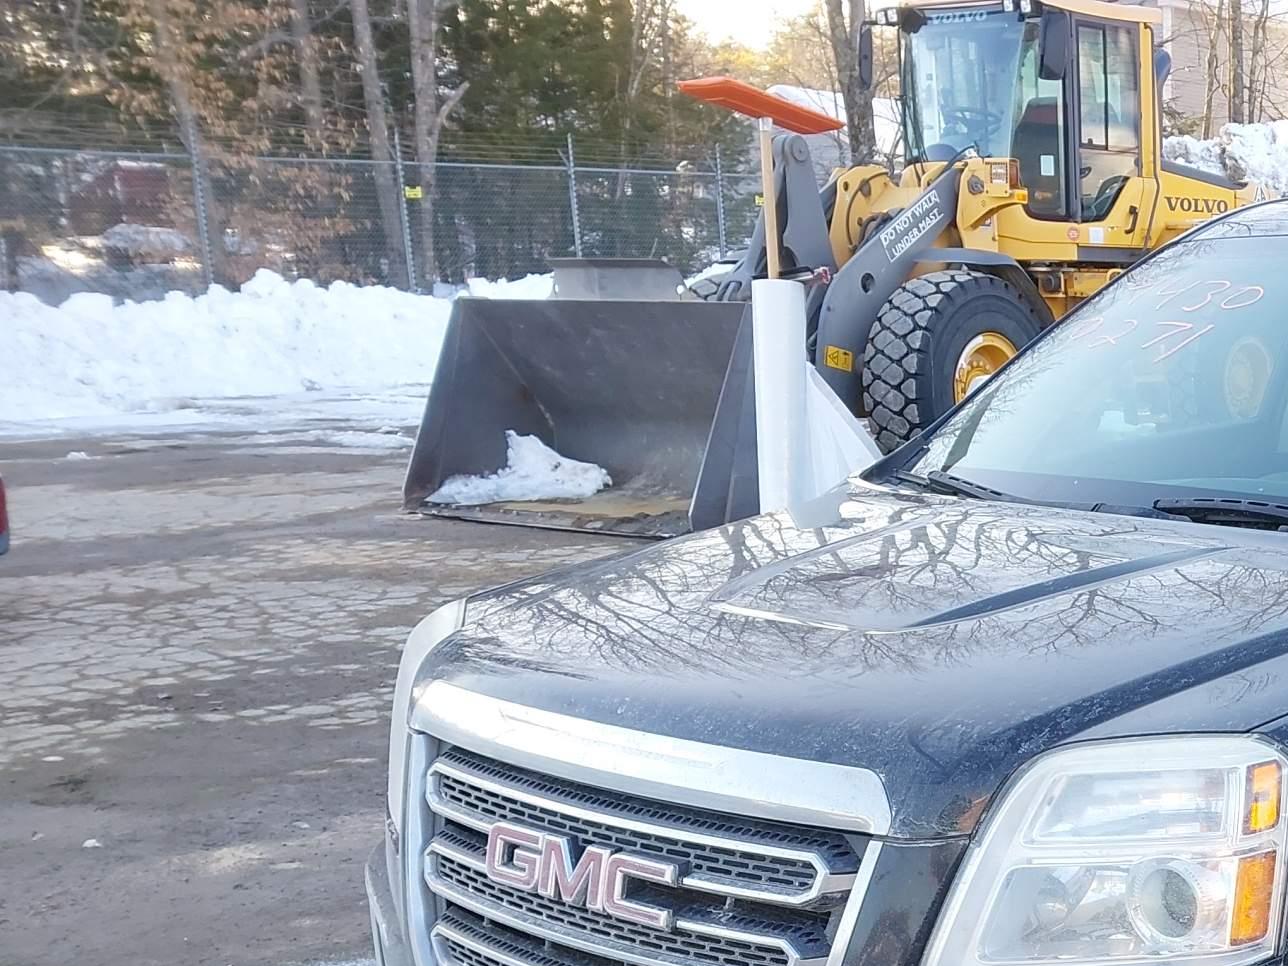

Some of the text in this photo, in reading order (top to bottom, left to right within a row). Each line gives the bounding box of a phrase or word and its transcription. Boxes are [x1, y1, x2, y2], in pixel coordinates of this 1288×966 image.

[933, 11, 986, 24] VOLVO
[881, 192, 939, 246] DO NOT WALK
[1165, 196, 1228, 213] VOLVO
[892, 207, 941, 257] UNDER MAST
[1070, 317, 1216, 363] 0271
[487, 822, 678, 931] GMC
